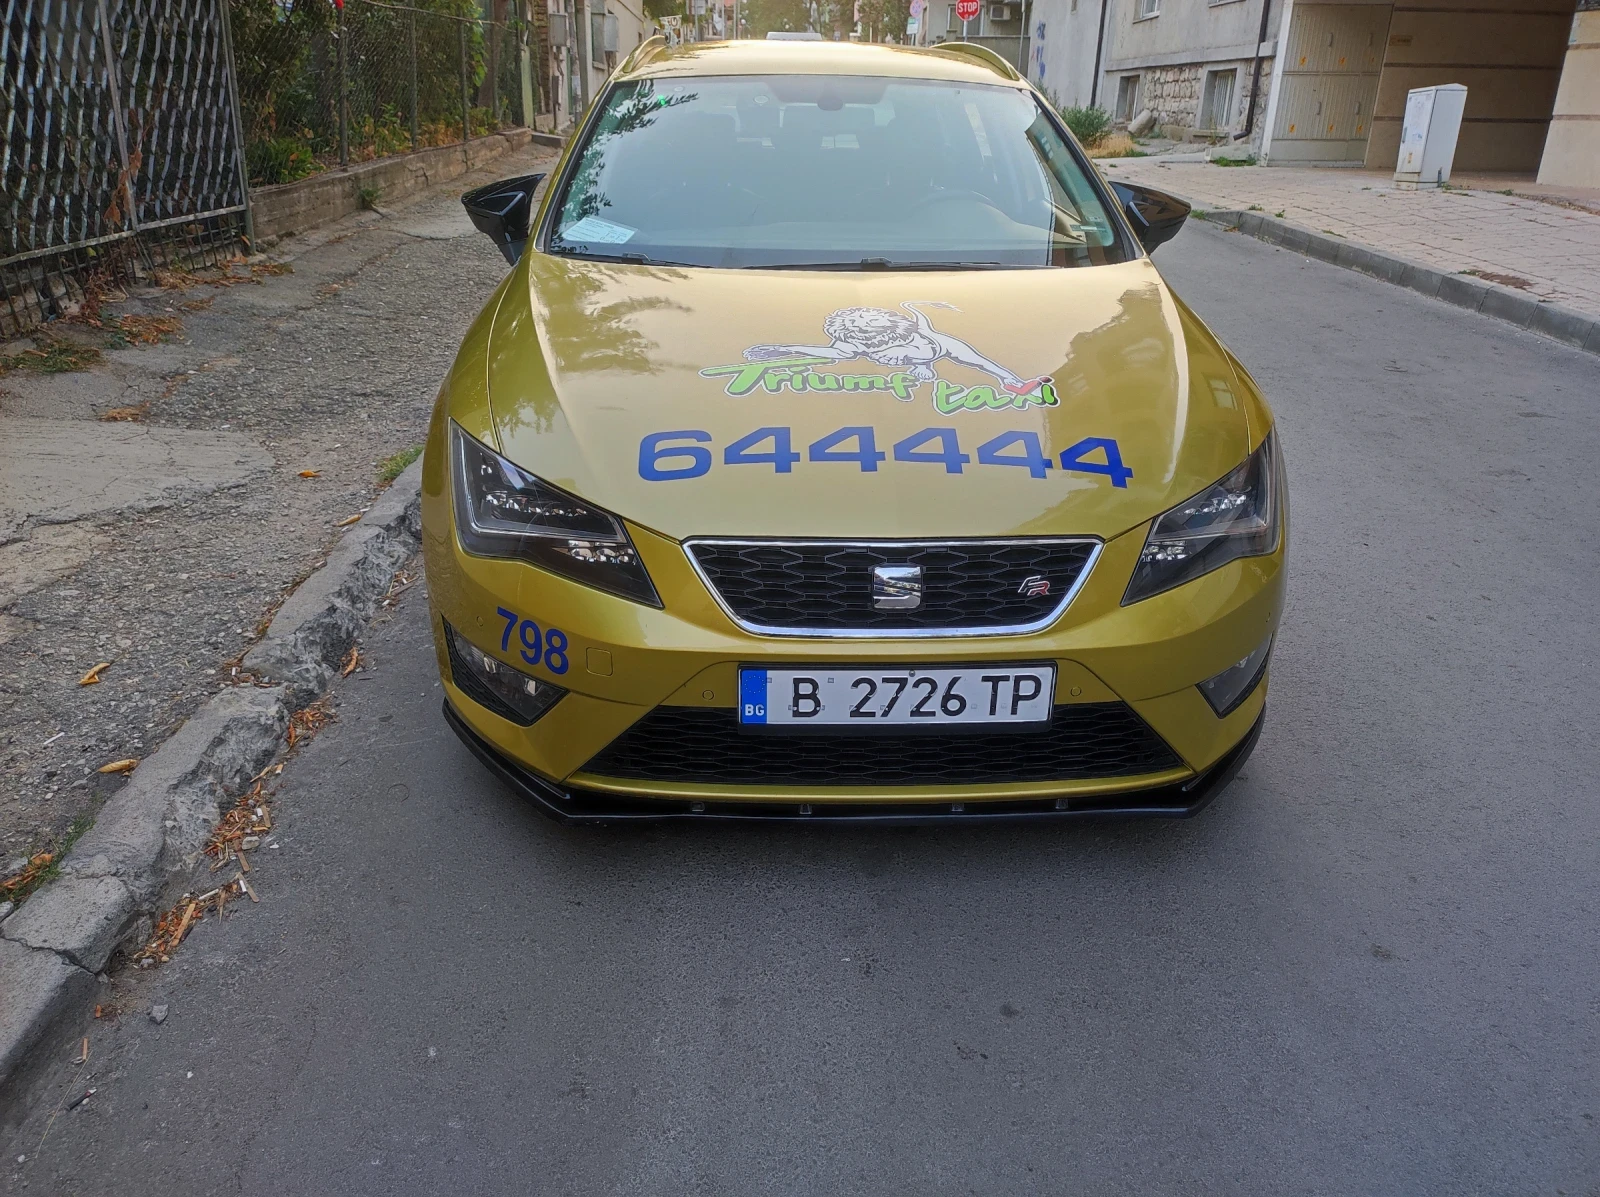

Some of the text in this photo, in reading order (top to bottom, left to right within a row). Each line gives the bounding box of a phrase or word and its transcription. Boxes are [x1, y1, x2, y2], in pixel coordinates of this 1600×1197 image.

[958, 2, 977, 12] STOP
[699, 356, 1061, 415] Triumf taxi
[638, 426, 1134, 489] 644444
[1017, 575, 1050, 596] FR
[497, 606, 569, 675] 798
[744, 705, 766, 716] BG
[791, 674, 1043, 718] B 2726 TP
